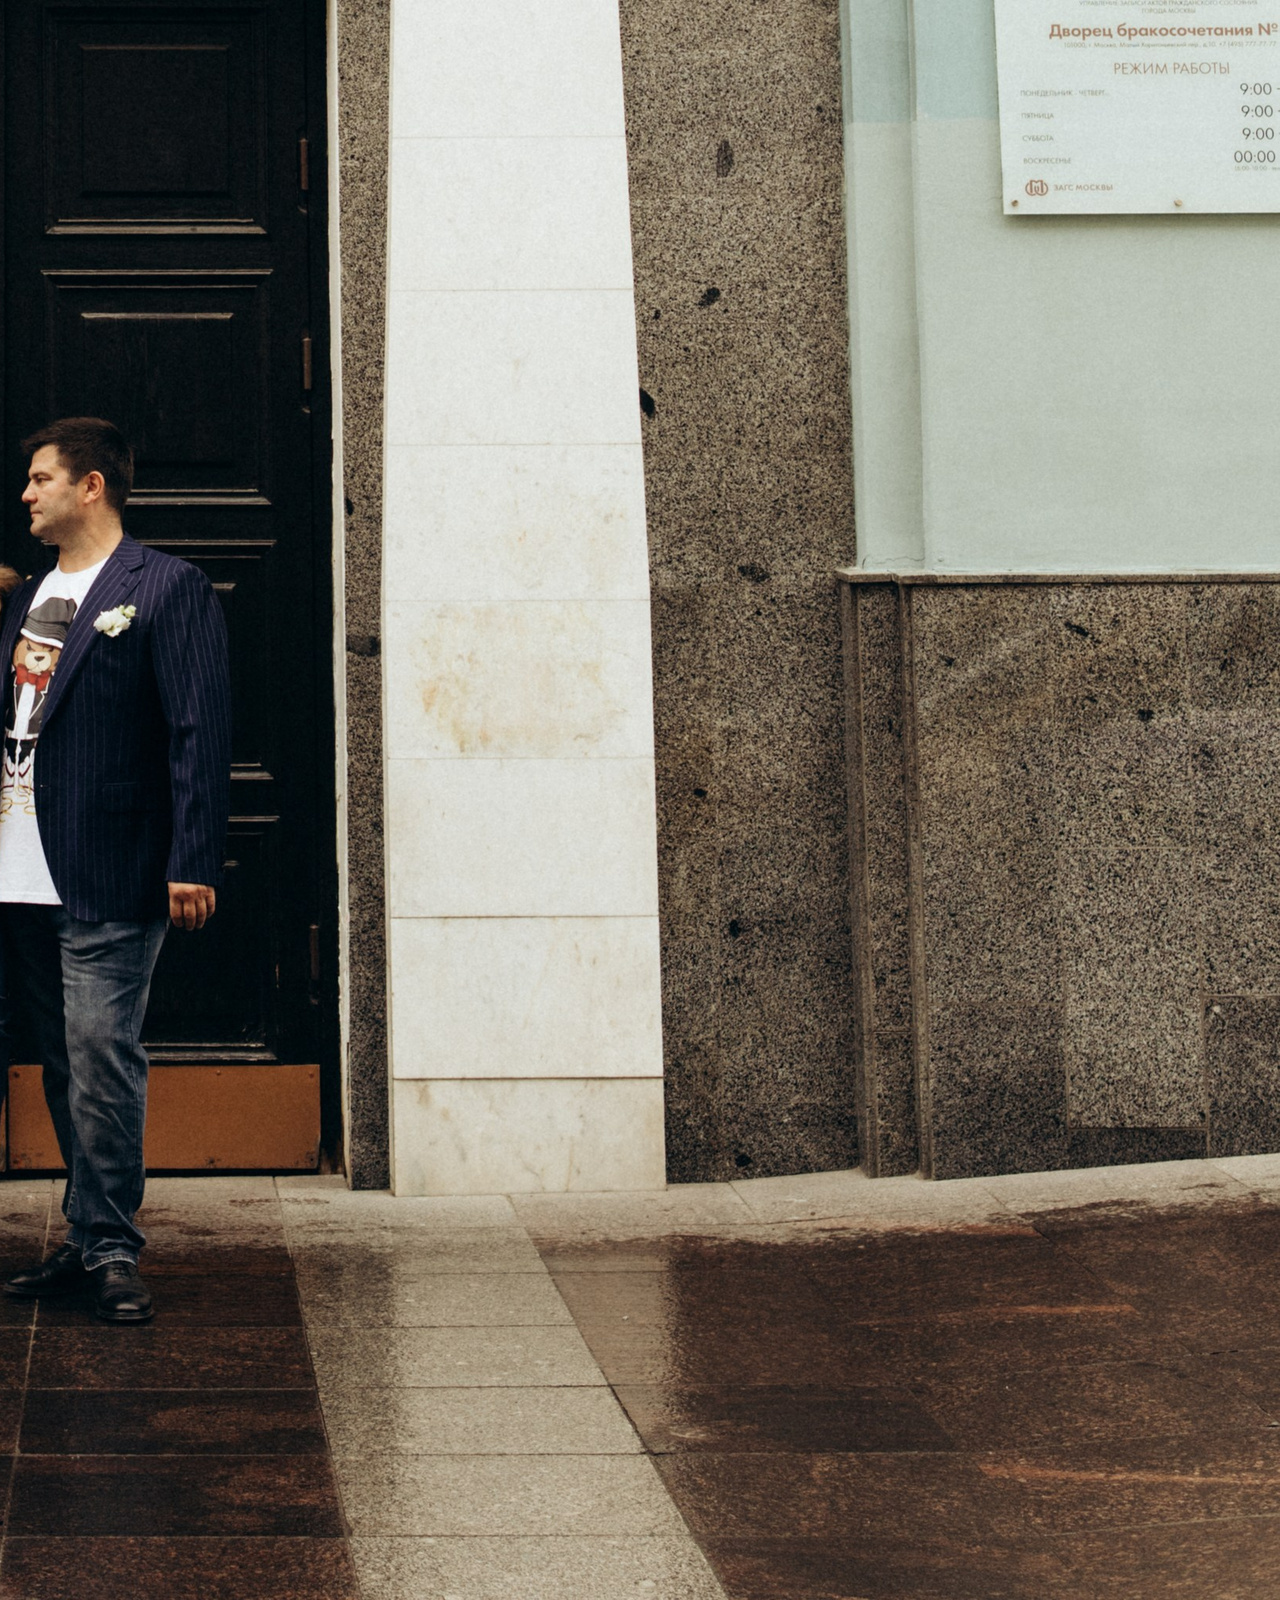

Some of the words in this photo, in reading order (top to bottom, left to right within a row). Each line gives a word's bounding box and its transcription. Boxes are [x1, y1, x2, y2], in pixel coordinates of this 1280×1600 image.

[1049, 24, 1113, 40] Дворец
[1117, 22, 1253, 40] бракосочетания
[1114, 62, 1169, 75] РЕЖИМ
[1173, 62, 1230, 75] РАБОТЫ
[1240, 83, 1272, 95] 9:00
[1241, 105, 1274, 118] 9:00
[1242, 127, 1275, 140] 9:00
[1234, 150, 1276, 163] 00:00
